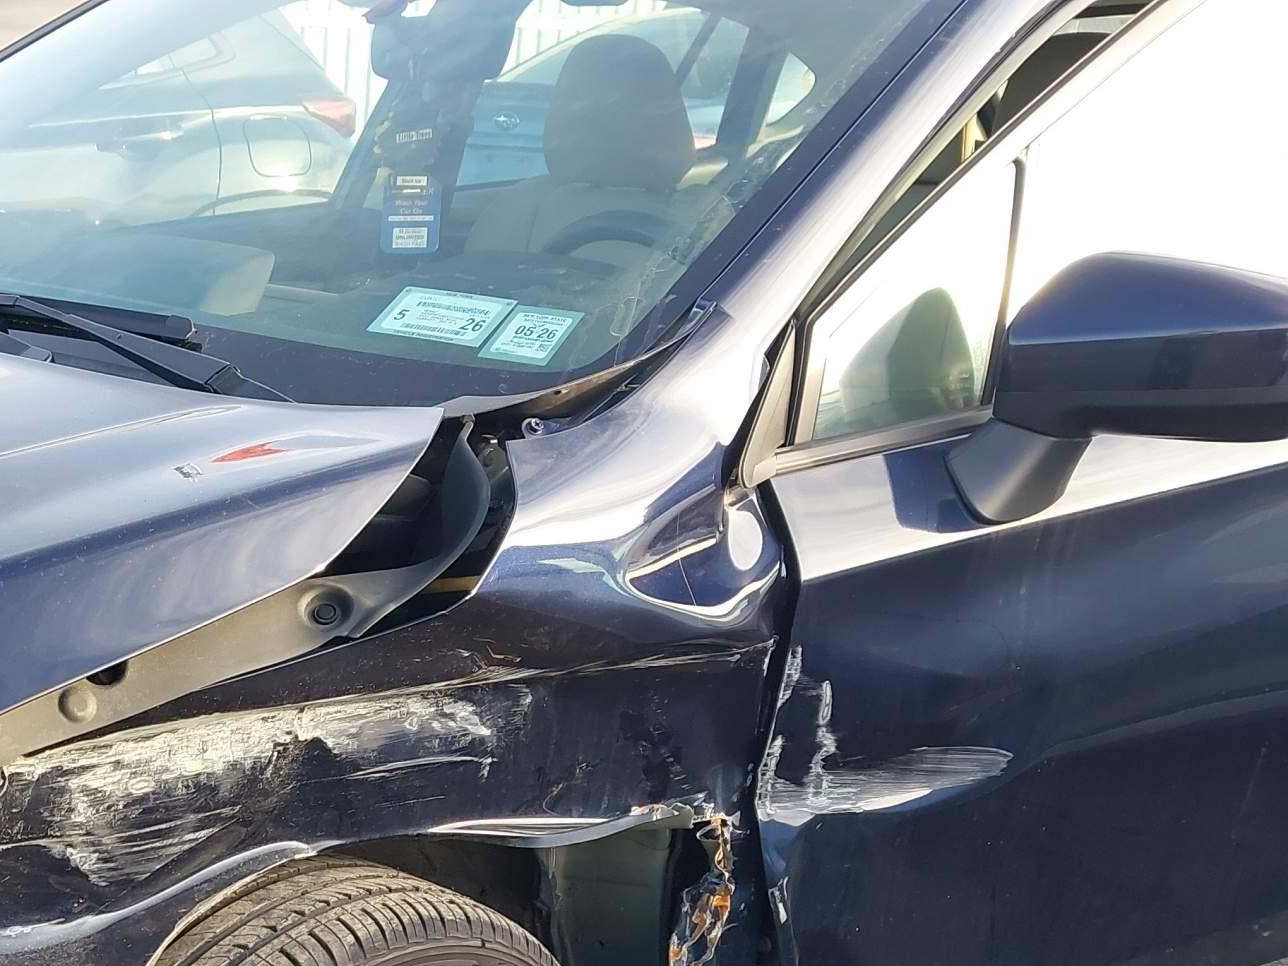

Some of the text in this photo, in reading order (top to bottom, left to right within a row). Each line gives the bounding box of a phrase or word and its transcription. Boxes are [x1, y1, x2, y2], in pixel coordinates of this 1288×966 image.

[393, 308, 410, 321] 5
[458, 317, 487, 333] 26
[514, 325, 537, 337] 05
[536, 327, 559, 340] 26
